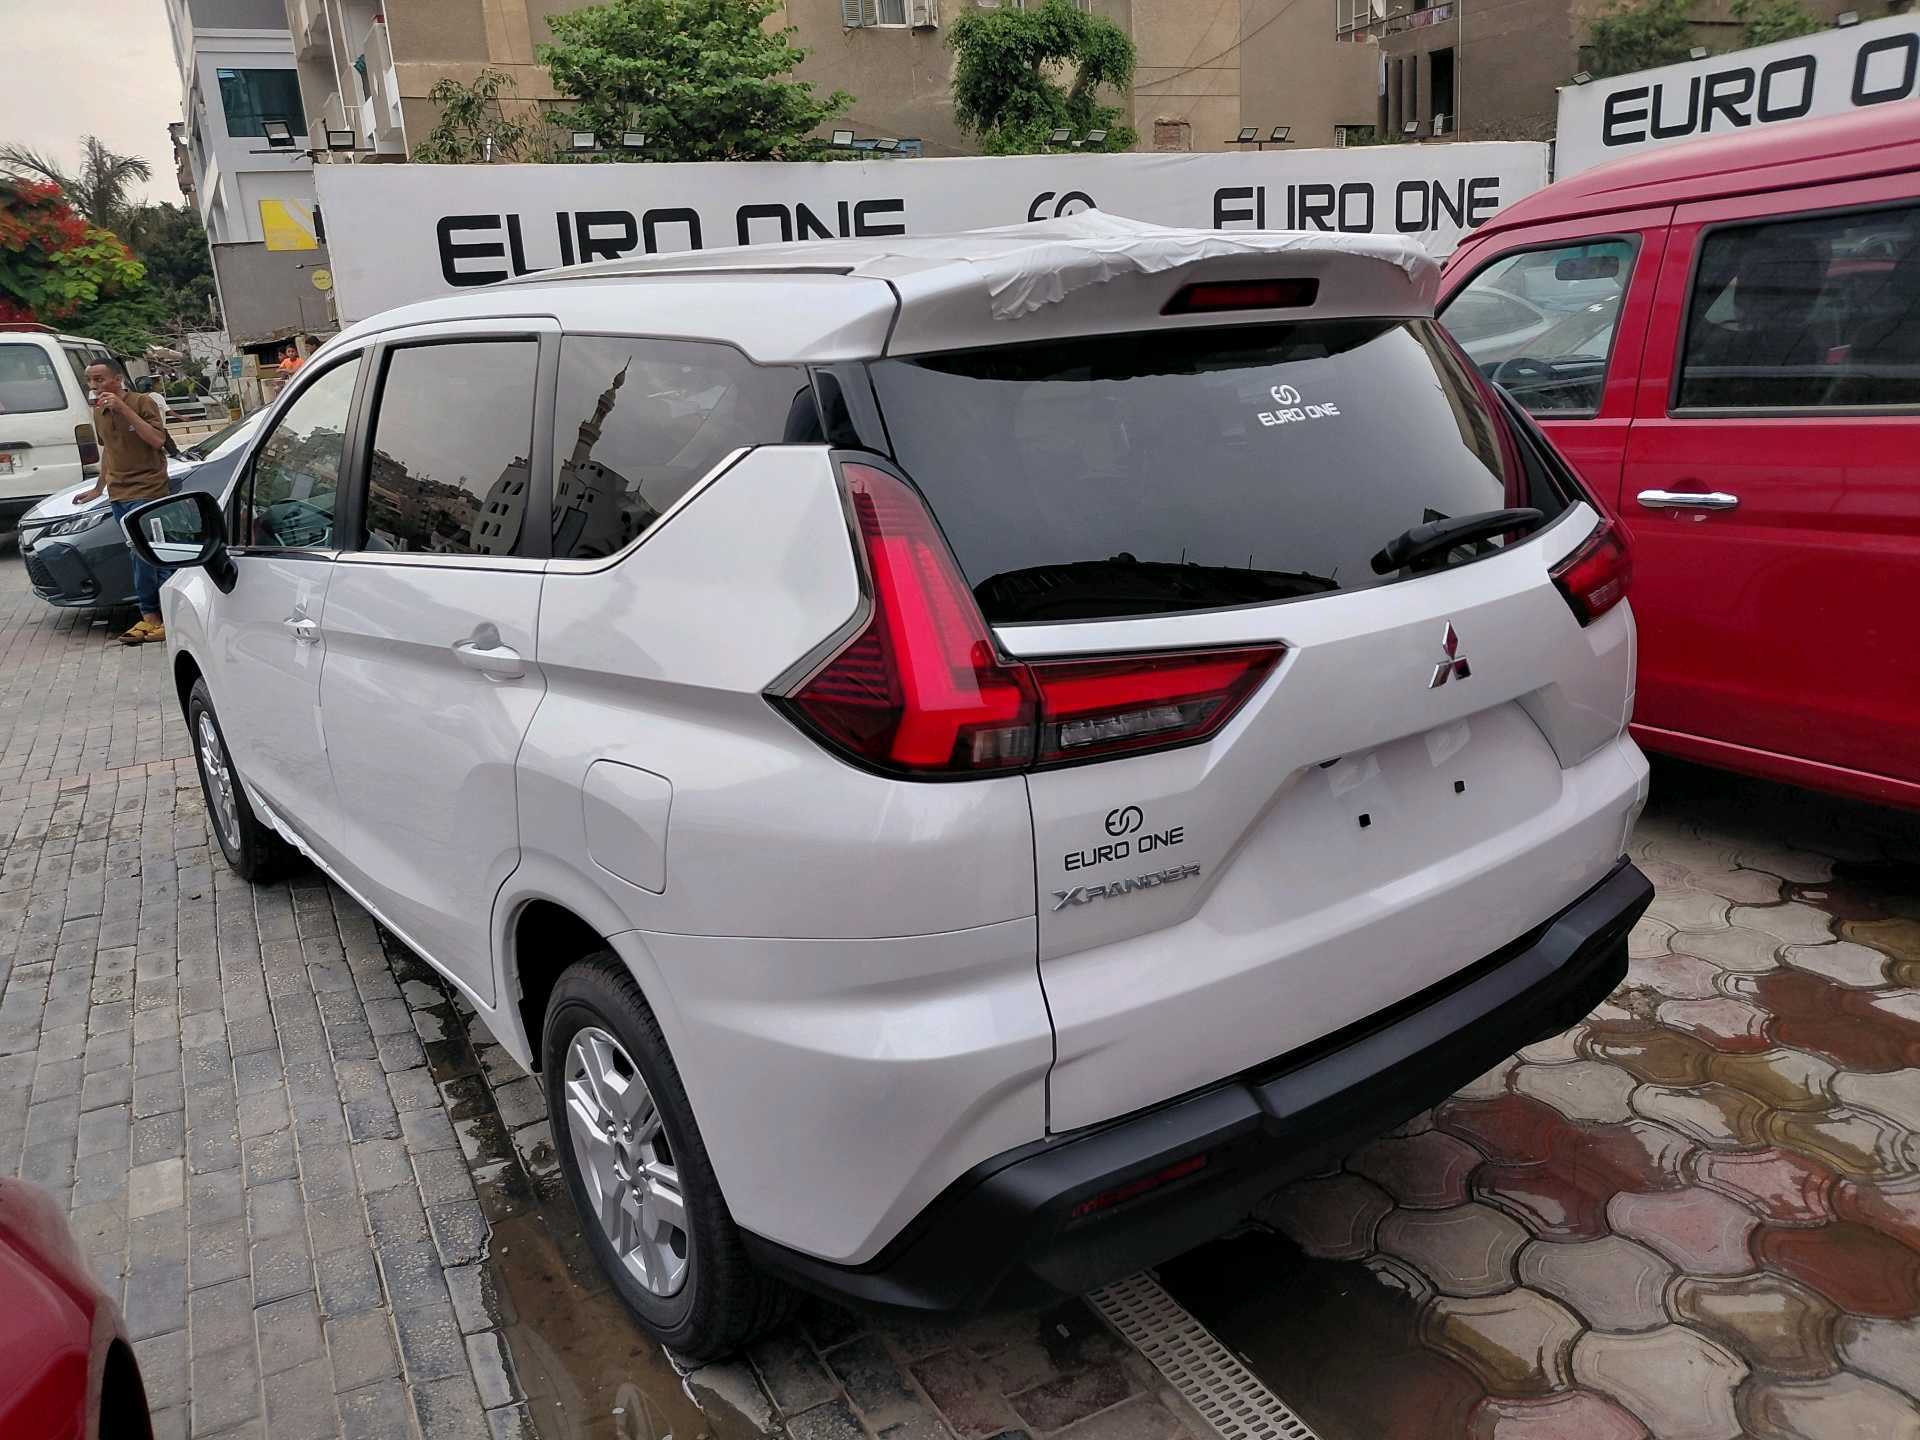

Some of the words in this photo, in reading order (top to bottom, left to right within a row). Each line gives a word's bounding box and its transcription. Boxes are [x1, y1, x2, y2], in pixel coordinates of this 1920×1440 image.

[1602, 54, 1817, 147] EURO
[1213, 177, 1374, 234] EURO
[1395, 177, 1500, 233] ONE
[436, 207, 703, 288] EURO
[1257, 407, 1306, 427] EURO
[1304, 402, 1341, 419] ONE
[1064, 841, 1130, 872] EURO
[1138, 826, 1184, 853] ONE
[1051, 862, 1201, 912] XPANDER
